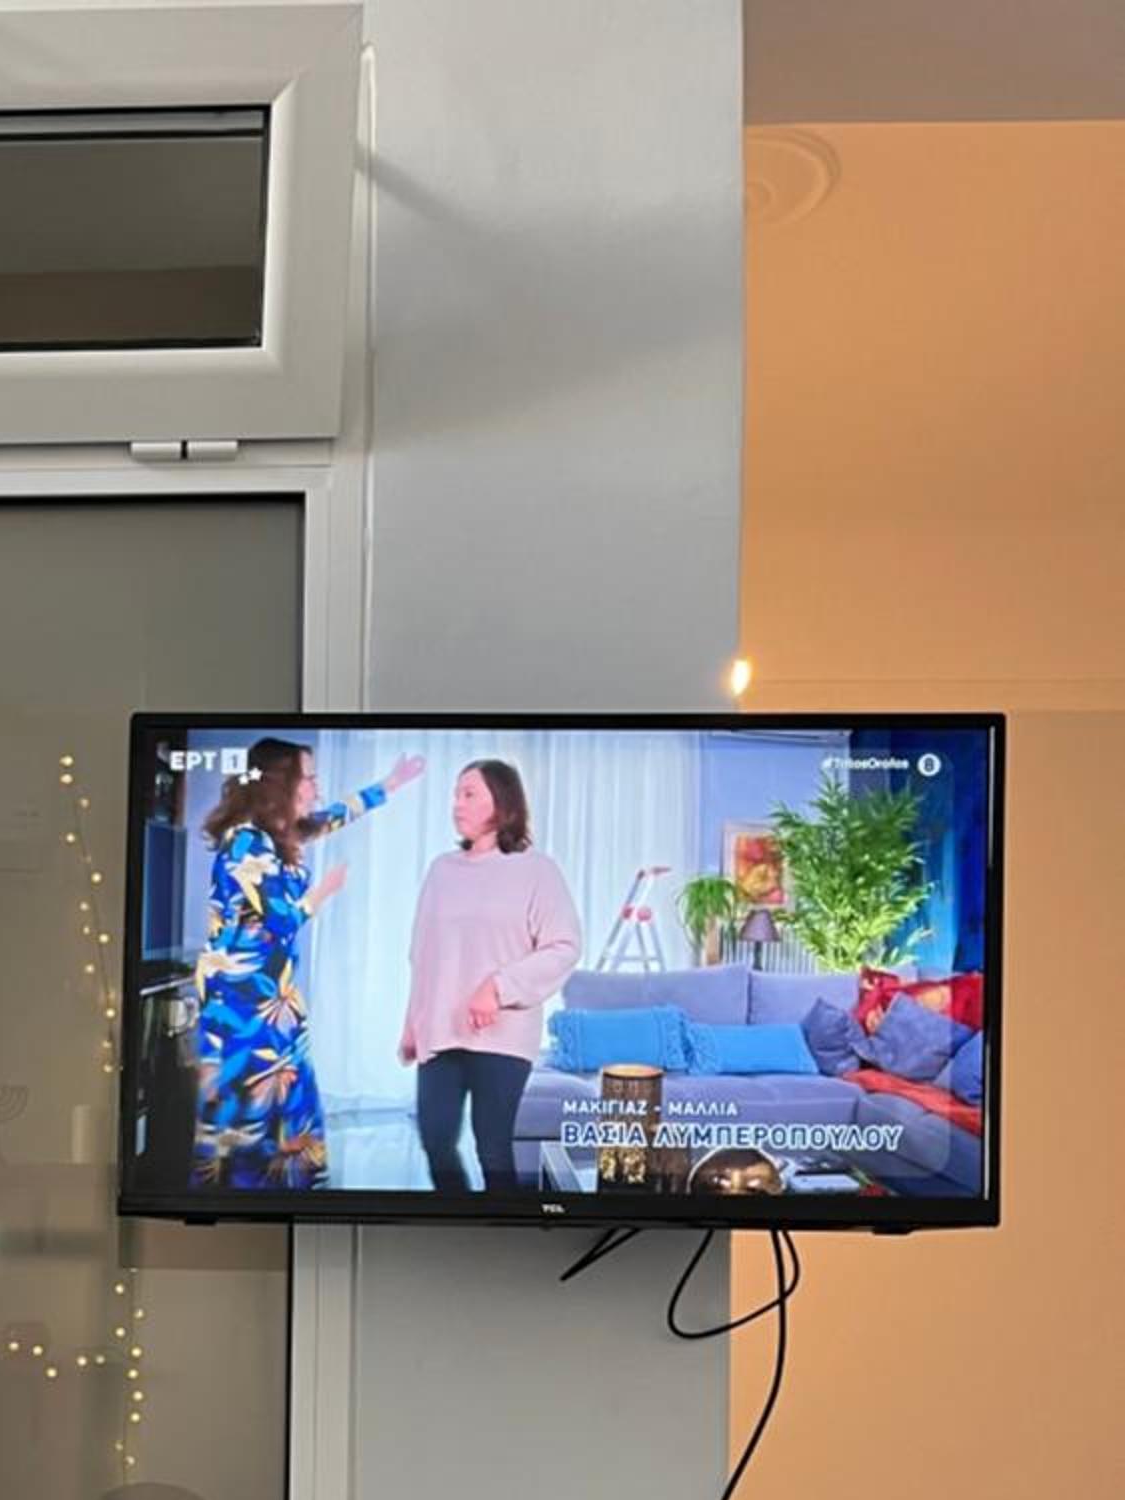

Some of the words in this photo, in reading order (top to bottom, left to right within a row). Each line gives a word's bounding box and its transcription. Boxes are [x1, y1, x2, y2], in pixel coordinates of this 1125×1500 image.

[169, 750, 218, 771] ΕΡΤ
[564, 1100, 648, 1115] ΜΑΚΙΓΙΑΖ
[668, 1102, 738, 1116] ΜΑΛΛΙΑ
[561, 1122, 647, 1148] ΒΑΣΙΑ
[655, 1123, 902, 1151] ΛΥΜΠΕΡΟΠΟΥΛΟΥ
